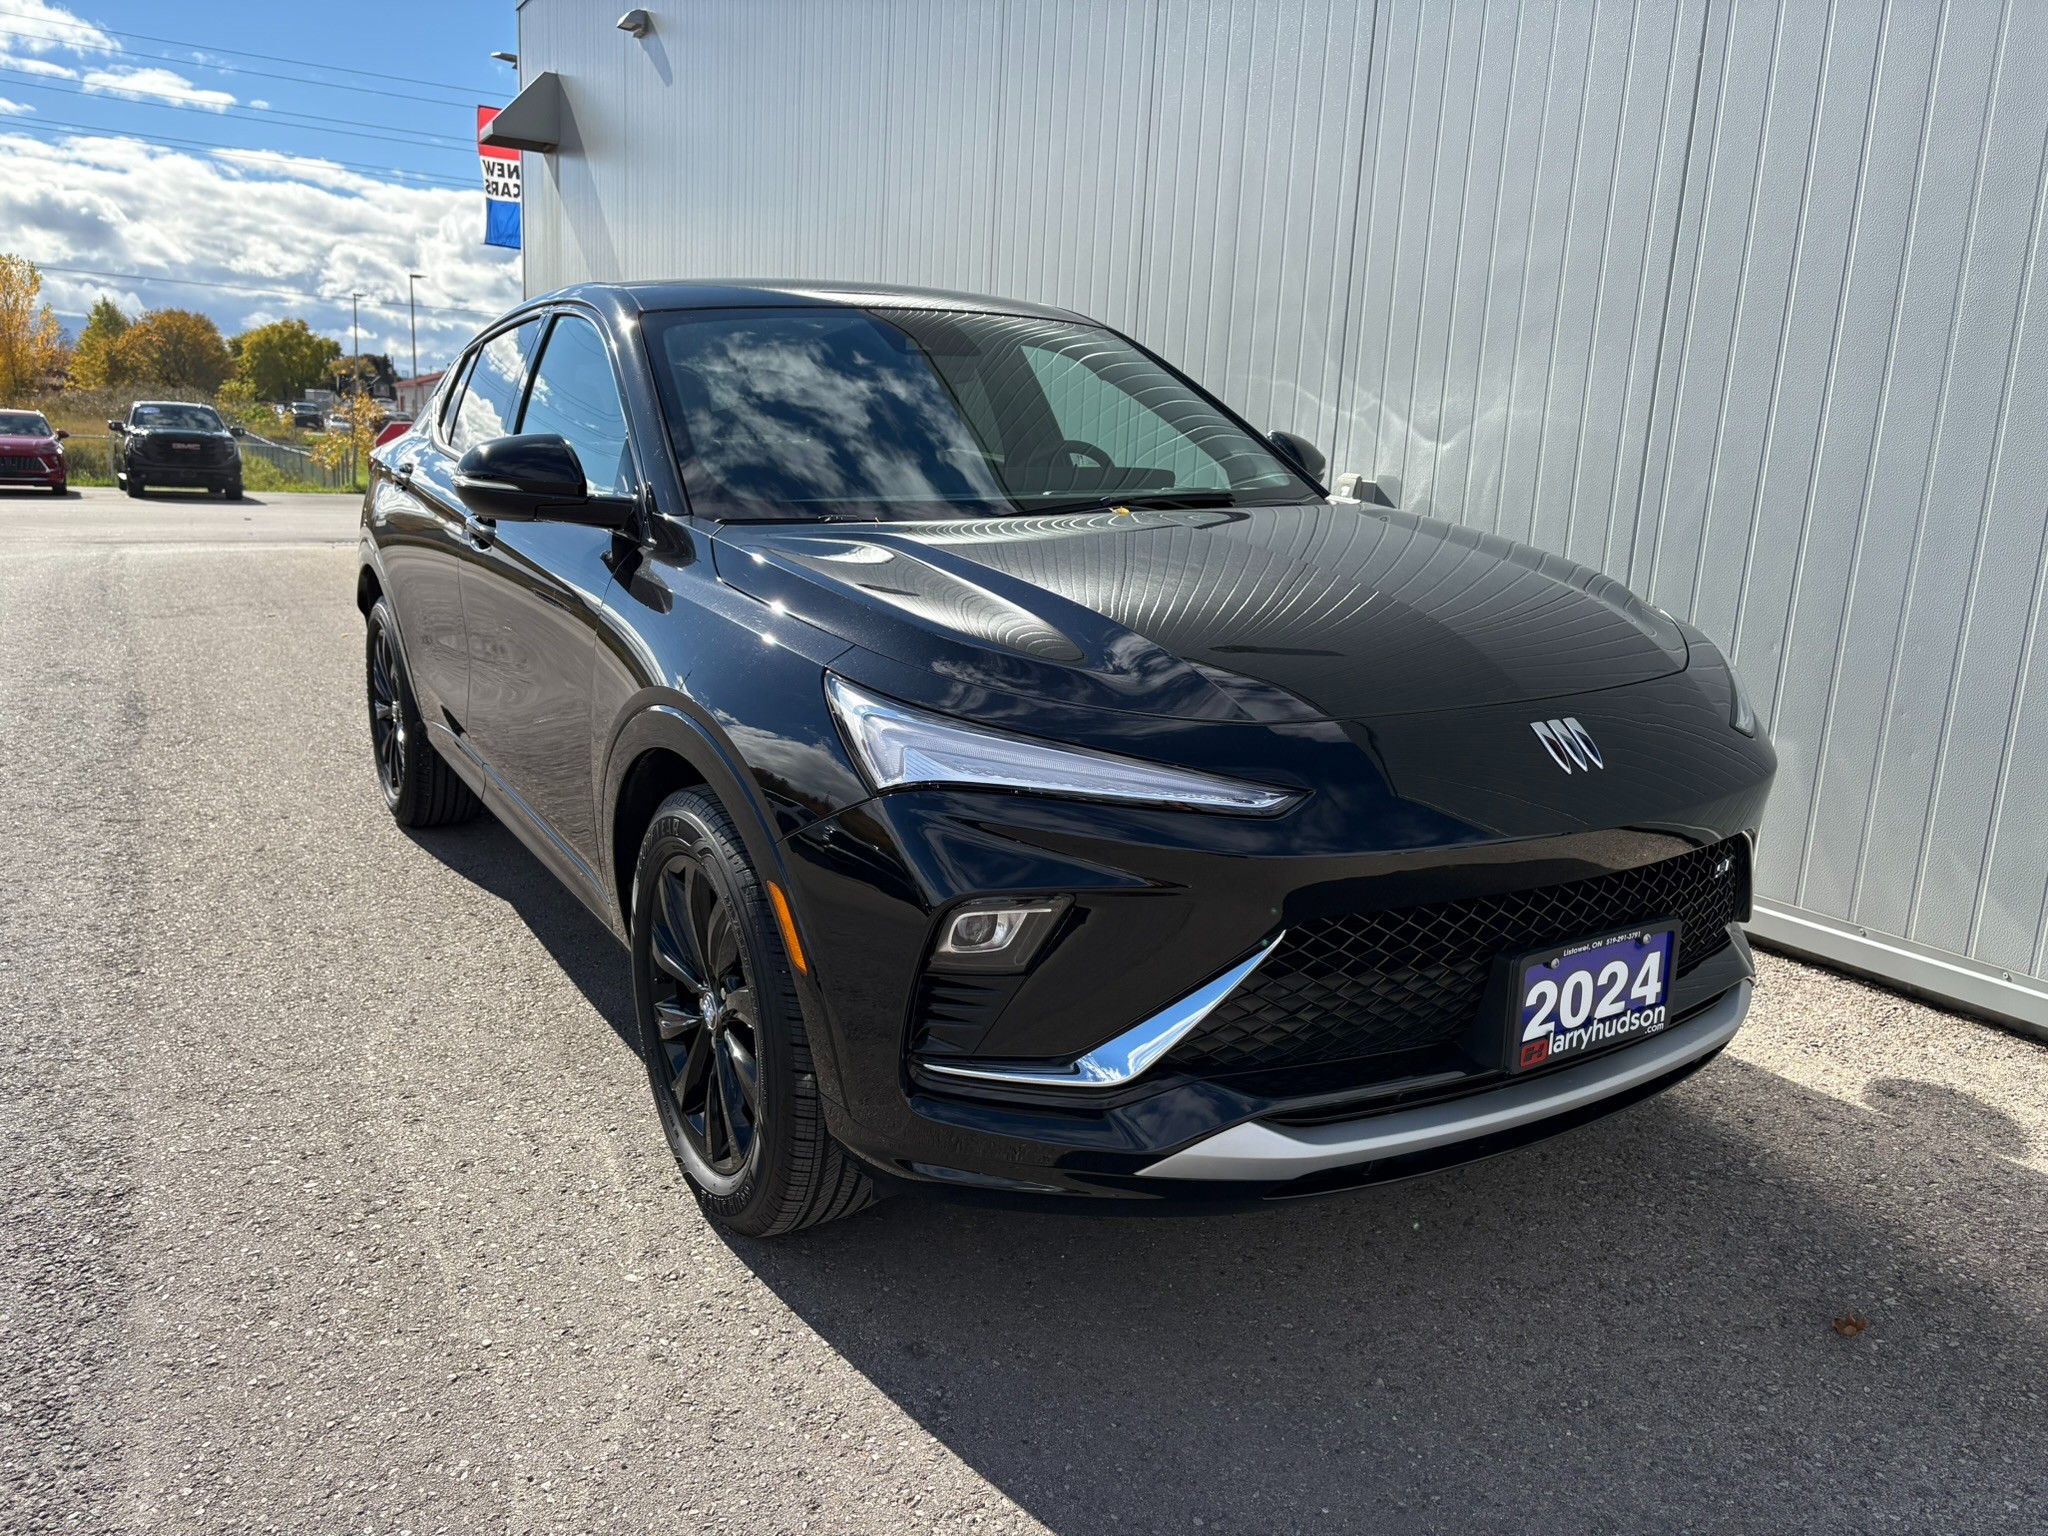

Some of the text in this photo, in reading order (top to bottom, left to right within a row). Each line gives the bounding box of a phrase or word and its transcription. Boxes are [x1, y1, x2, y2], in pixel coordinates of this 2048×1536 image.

[172, 442, 201, 451] GMC
[1592, 940, 1603, 949] ON
[1522, 951, 1661, 1043] 2024
[1548, 1005, 1665, 1055] larryhudson
[1645, 1022, 1664, 1035] .com
